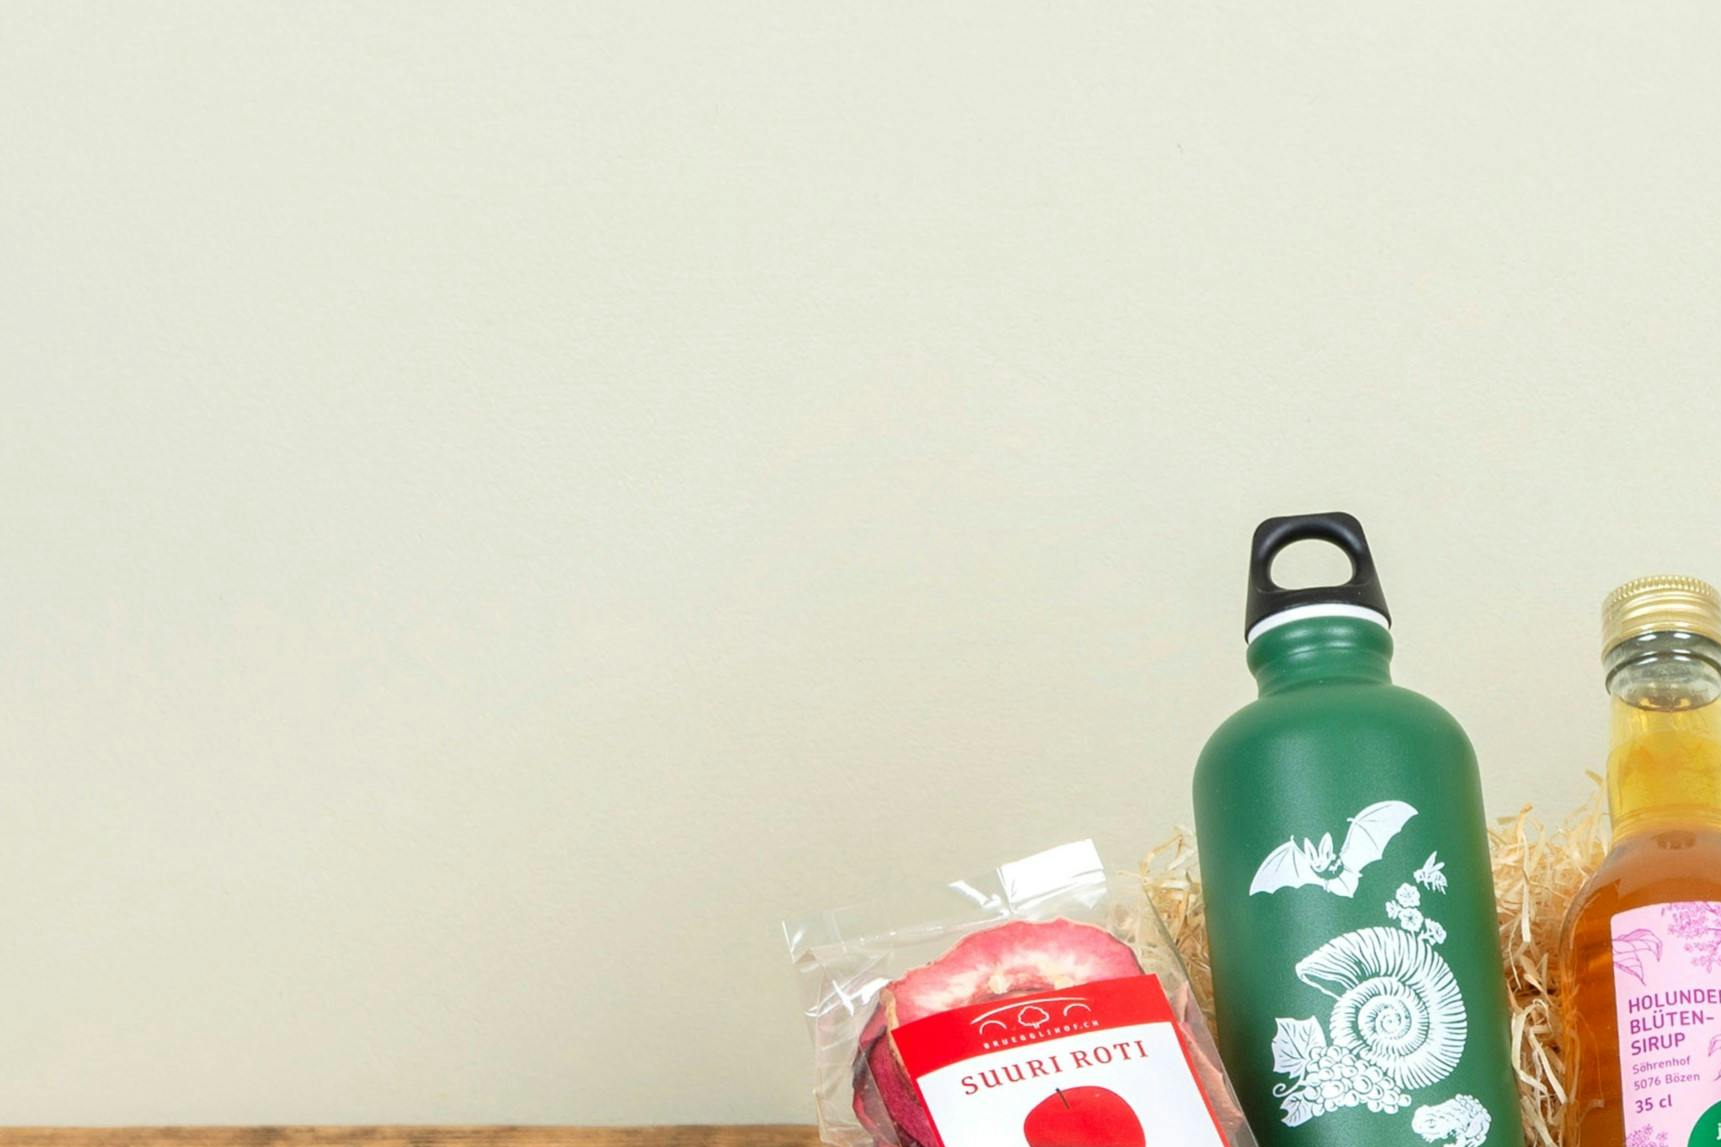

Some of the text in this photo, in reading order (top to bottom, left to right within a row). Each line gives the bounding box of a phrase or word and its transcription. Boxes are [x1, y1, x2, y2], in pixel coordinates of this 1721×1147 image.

[1629, 1009, 1715, 1035] BLÜTEN-
[1630, 1032, 1687, 1056] SIRUP
[960, 1039, 1149, 1096] SUURI ROTI
[1631, 1056, 1692, 1075] Söhrenhof
[1633, 1072, 1701, 1091] 5076 Bözen
[1634, 1095, 1673, 1114] 35 cl
